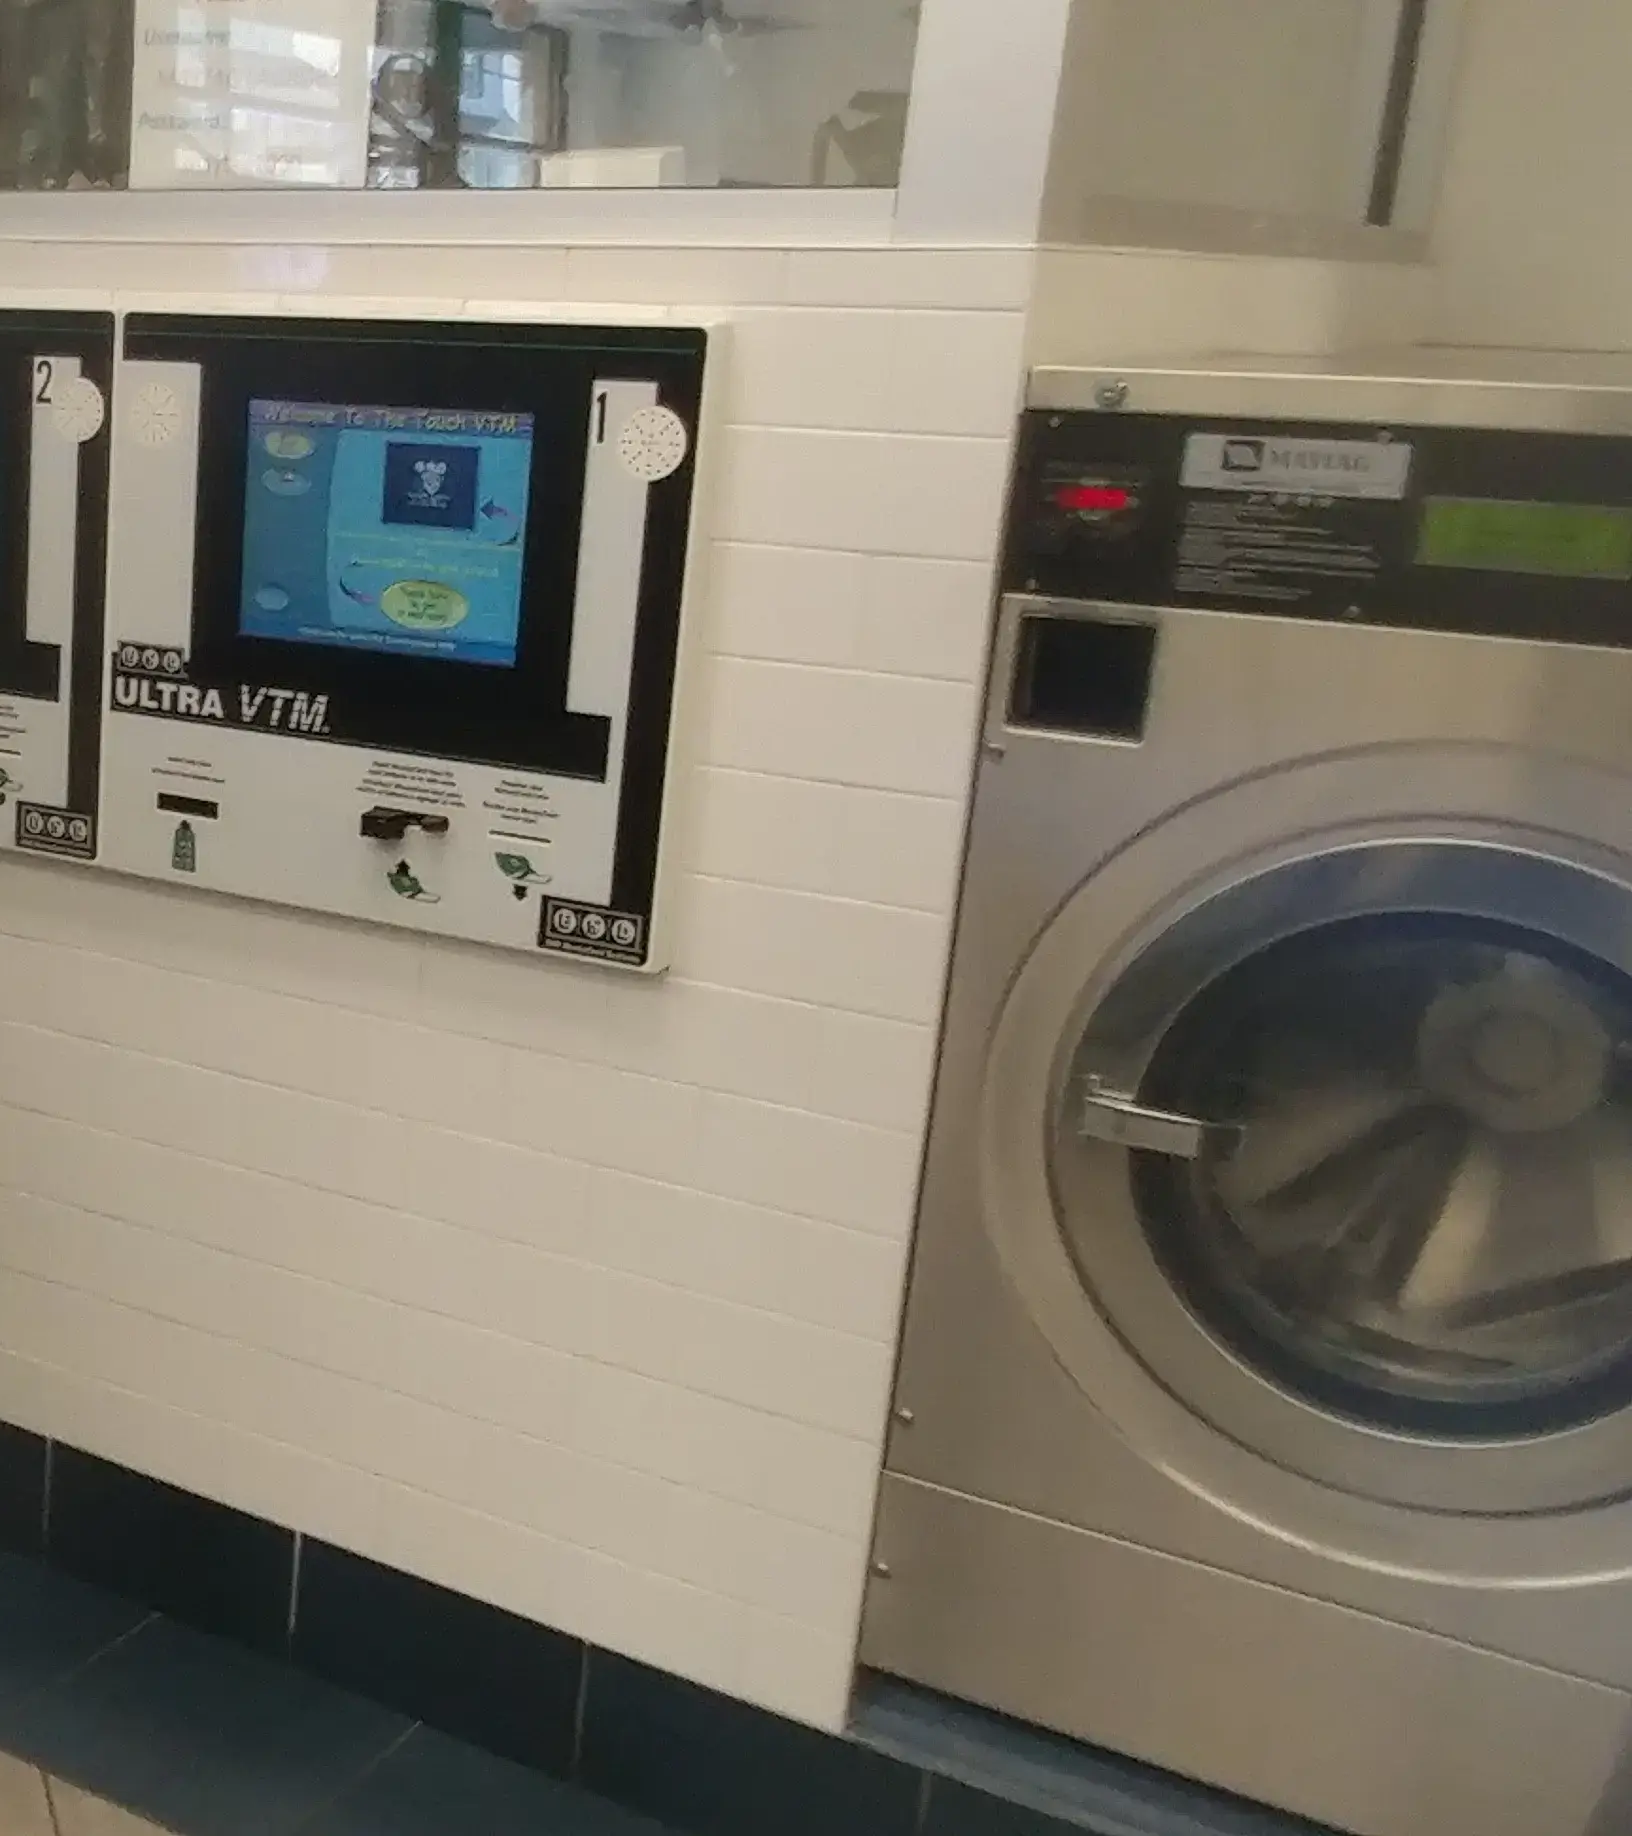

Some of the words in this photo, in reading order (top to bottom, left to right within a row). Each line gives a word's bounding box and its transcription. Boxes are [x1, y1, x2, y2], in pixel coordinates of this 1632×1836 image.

[36, 360, 52, 404] 2
[596, 391, 608, 444] 1
[115, 675, 225, 719] ULTRA
[240, 684, 331, 734] VTM
